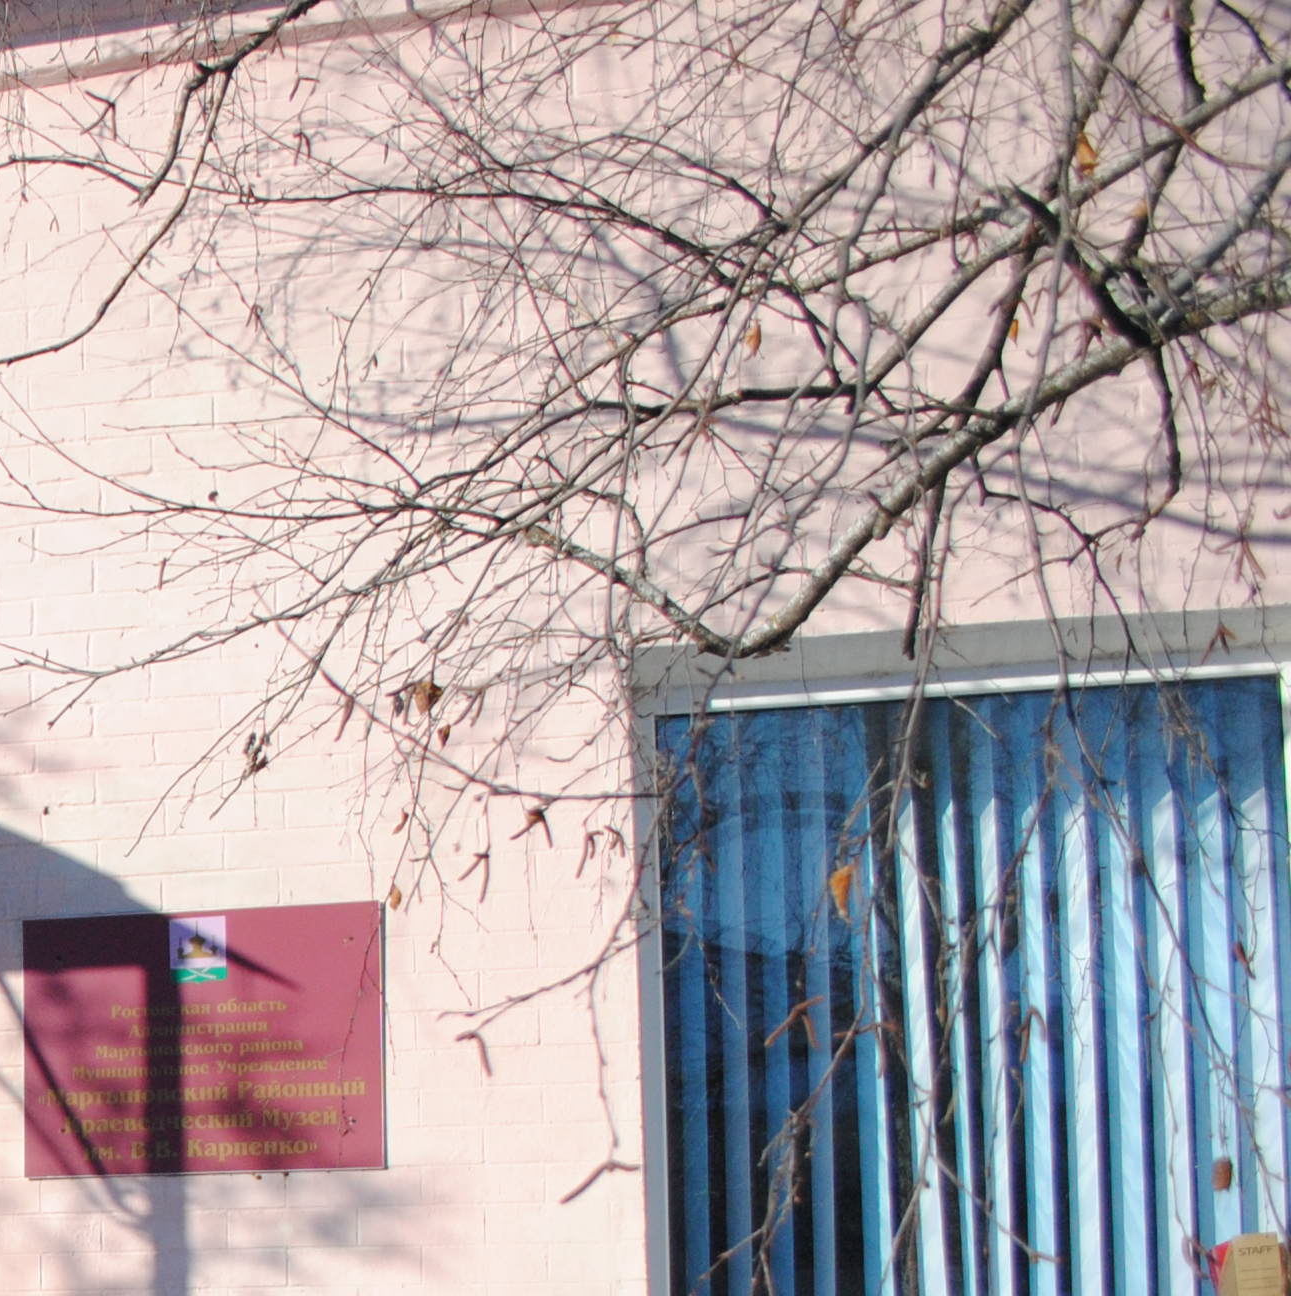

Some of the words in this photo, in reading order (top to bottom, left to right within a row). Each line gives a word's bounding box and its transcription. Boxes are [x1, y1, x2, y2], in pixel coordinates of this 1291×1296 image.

[110, 1003, 210, 1020] Ростовская
[216, 998, 288, 1013] область
[239, 1037, 304, 1055] района
[215, 1058, 329, 1076] Учреждение
[237, 1076, 366, 1100] Районный
[262, 1108, 339, 1131] Музей
[130, 1140, 178, 1159] В.В.
[186, 1137, 319, 1162] Карпенко»
[1238, 1247, 1274, 1257] STAFF
